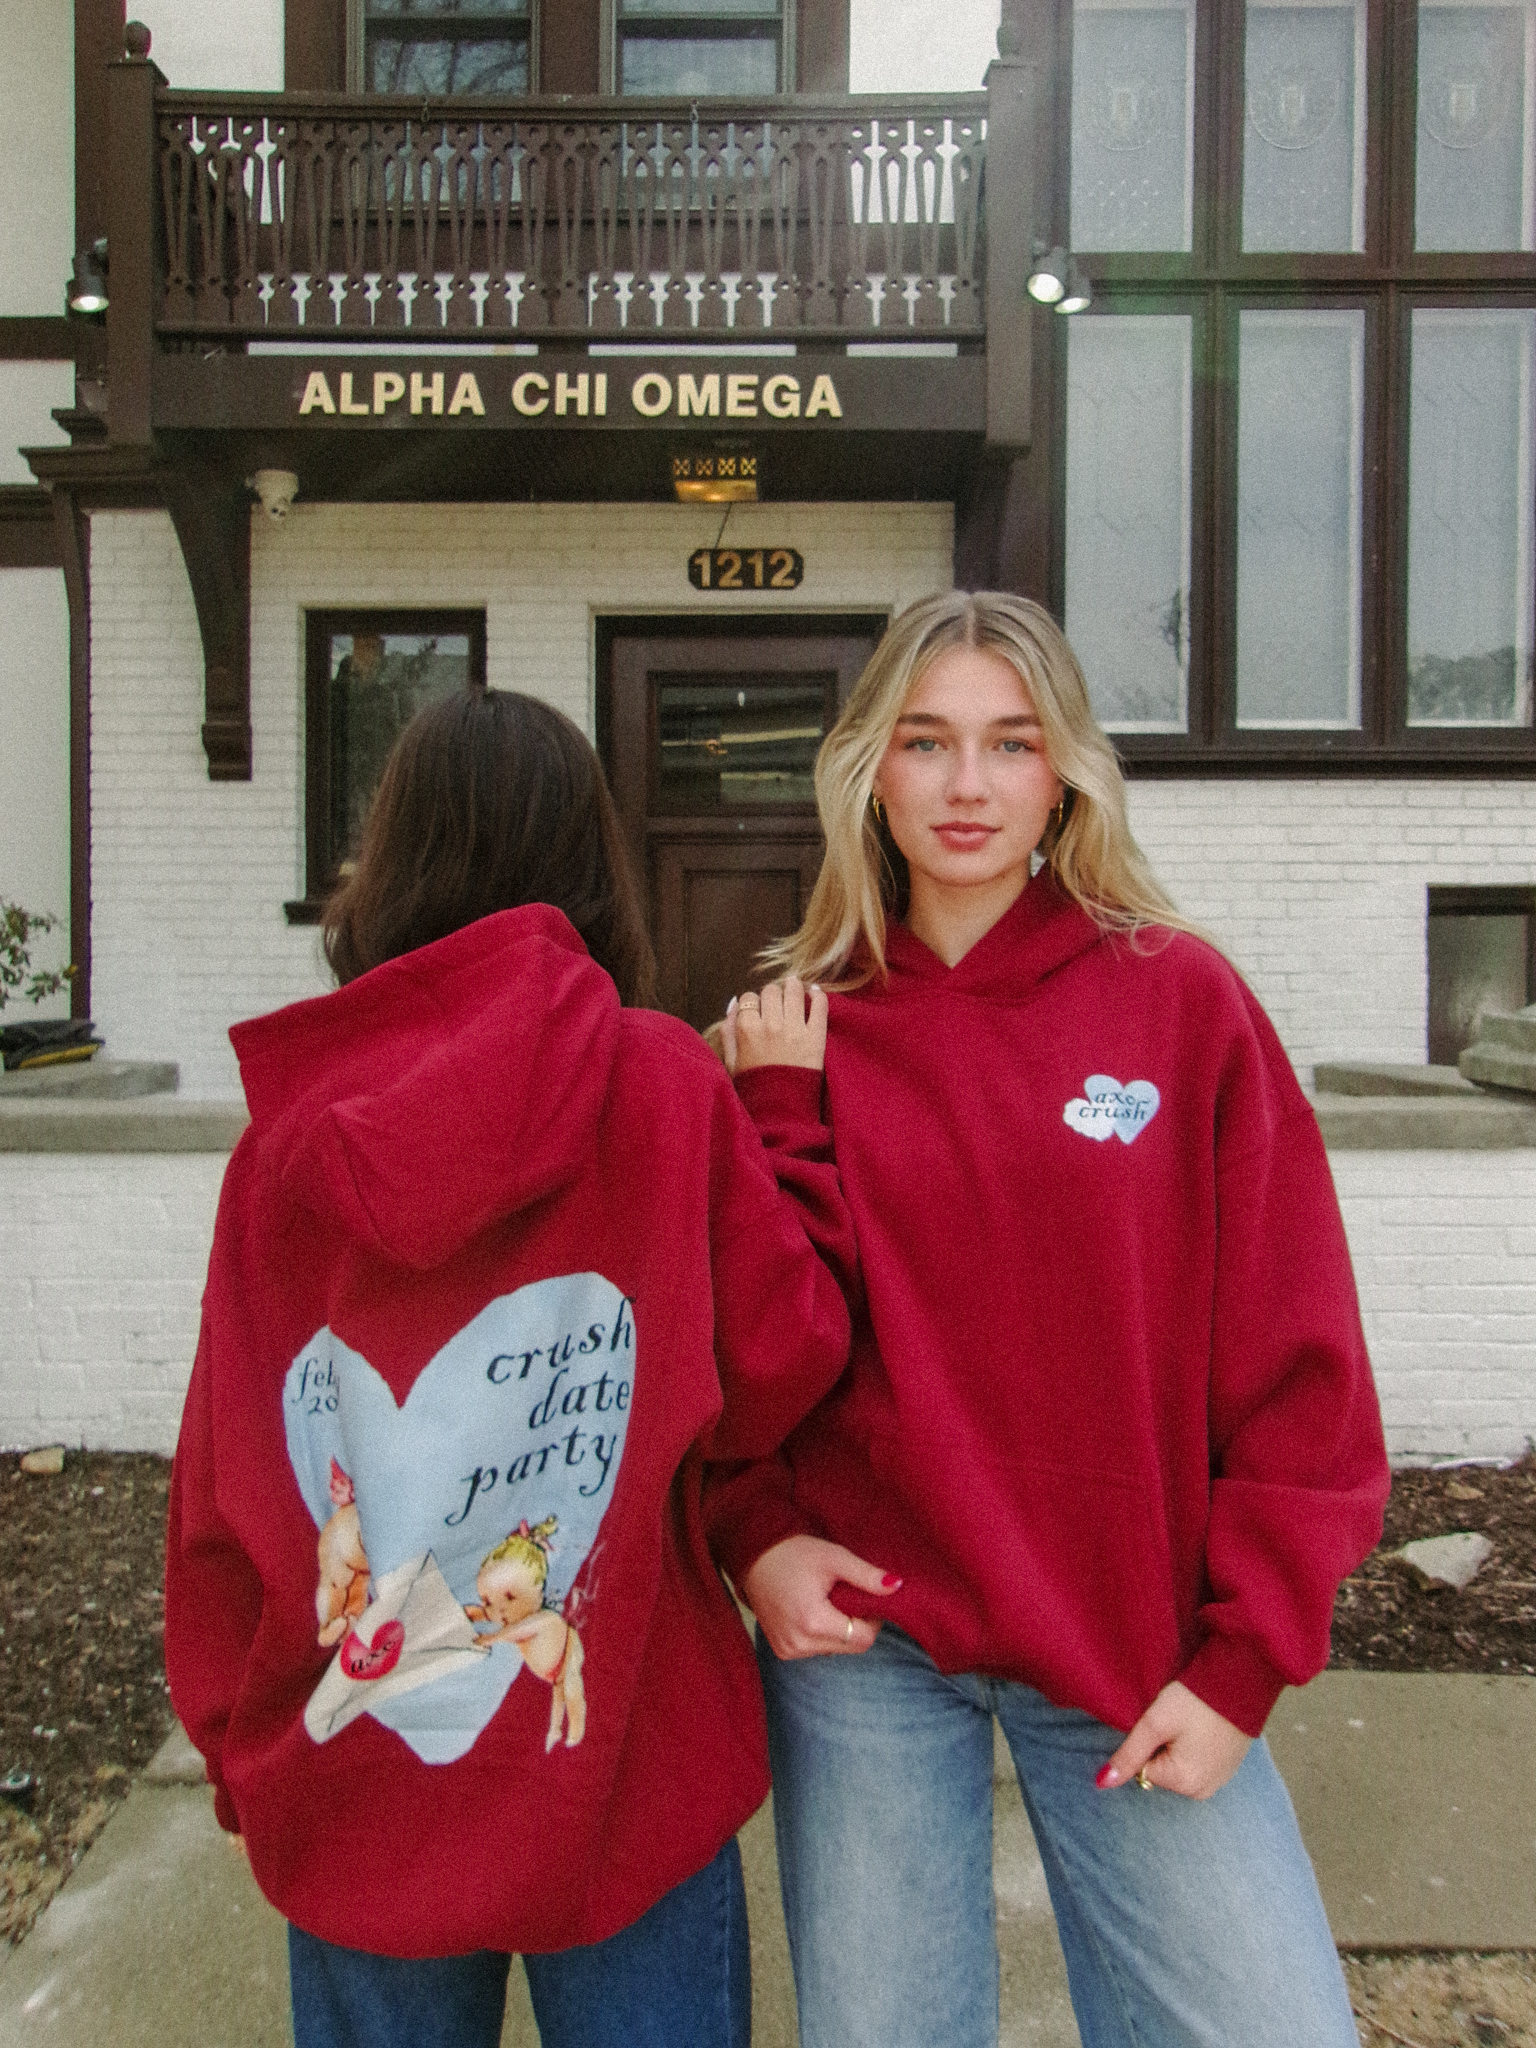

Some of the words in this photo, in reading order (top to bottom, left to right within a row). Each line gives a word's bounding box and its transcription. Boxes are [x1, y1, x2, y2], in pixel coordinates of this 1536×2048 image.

[299, 371, 486, 416] ALPHA
[511, 372, 607, 416] CHI
[631, 373, 843, 418] OMEGA
[694, 551, 796, 587] 1212
[1079, 1100, 1149, 1120] crush
[1095, 1092, 1136, 1105] axo
[486, 1296, 636, 1384] crush
[528, 1367, 630, 1429] date
[444, 1425, 617, 1526] party
